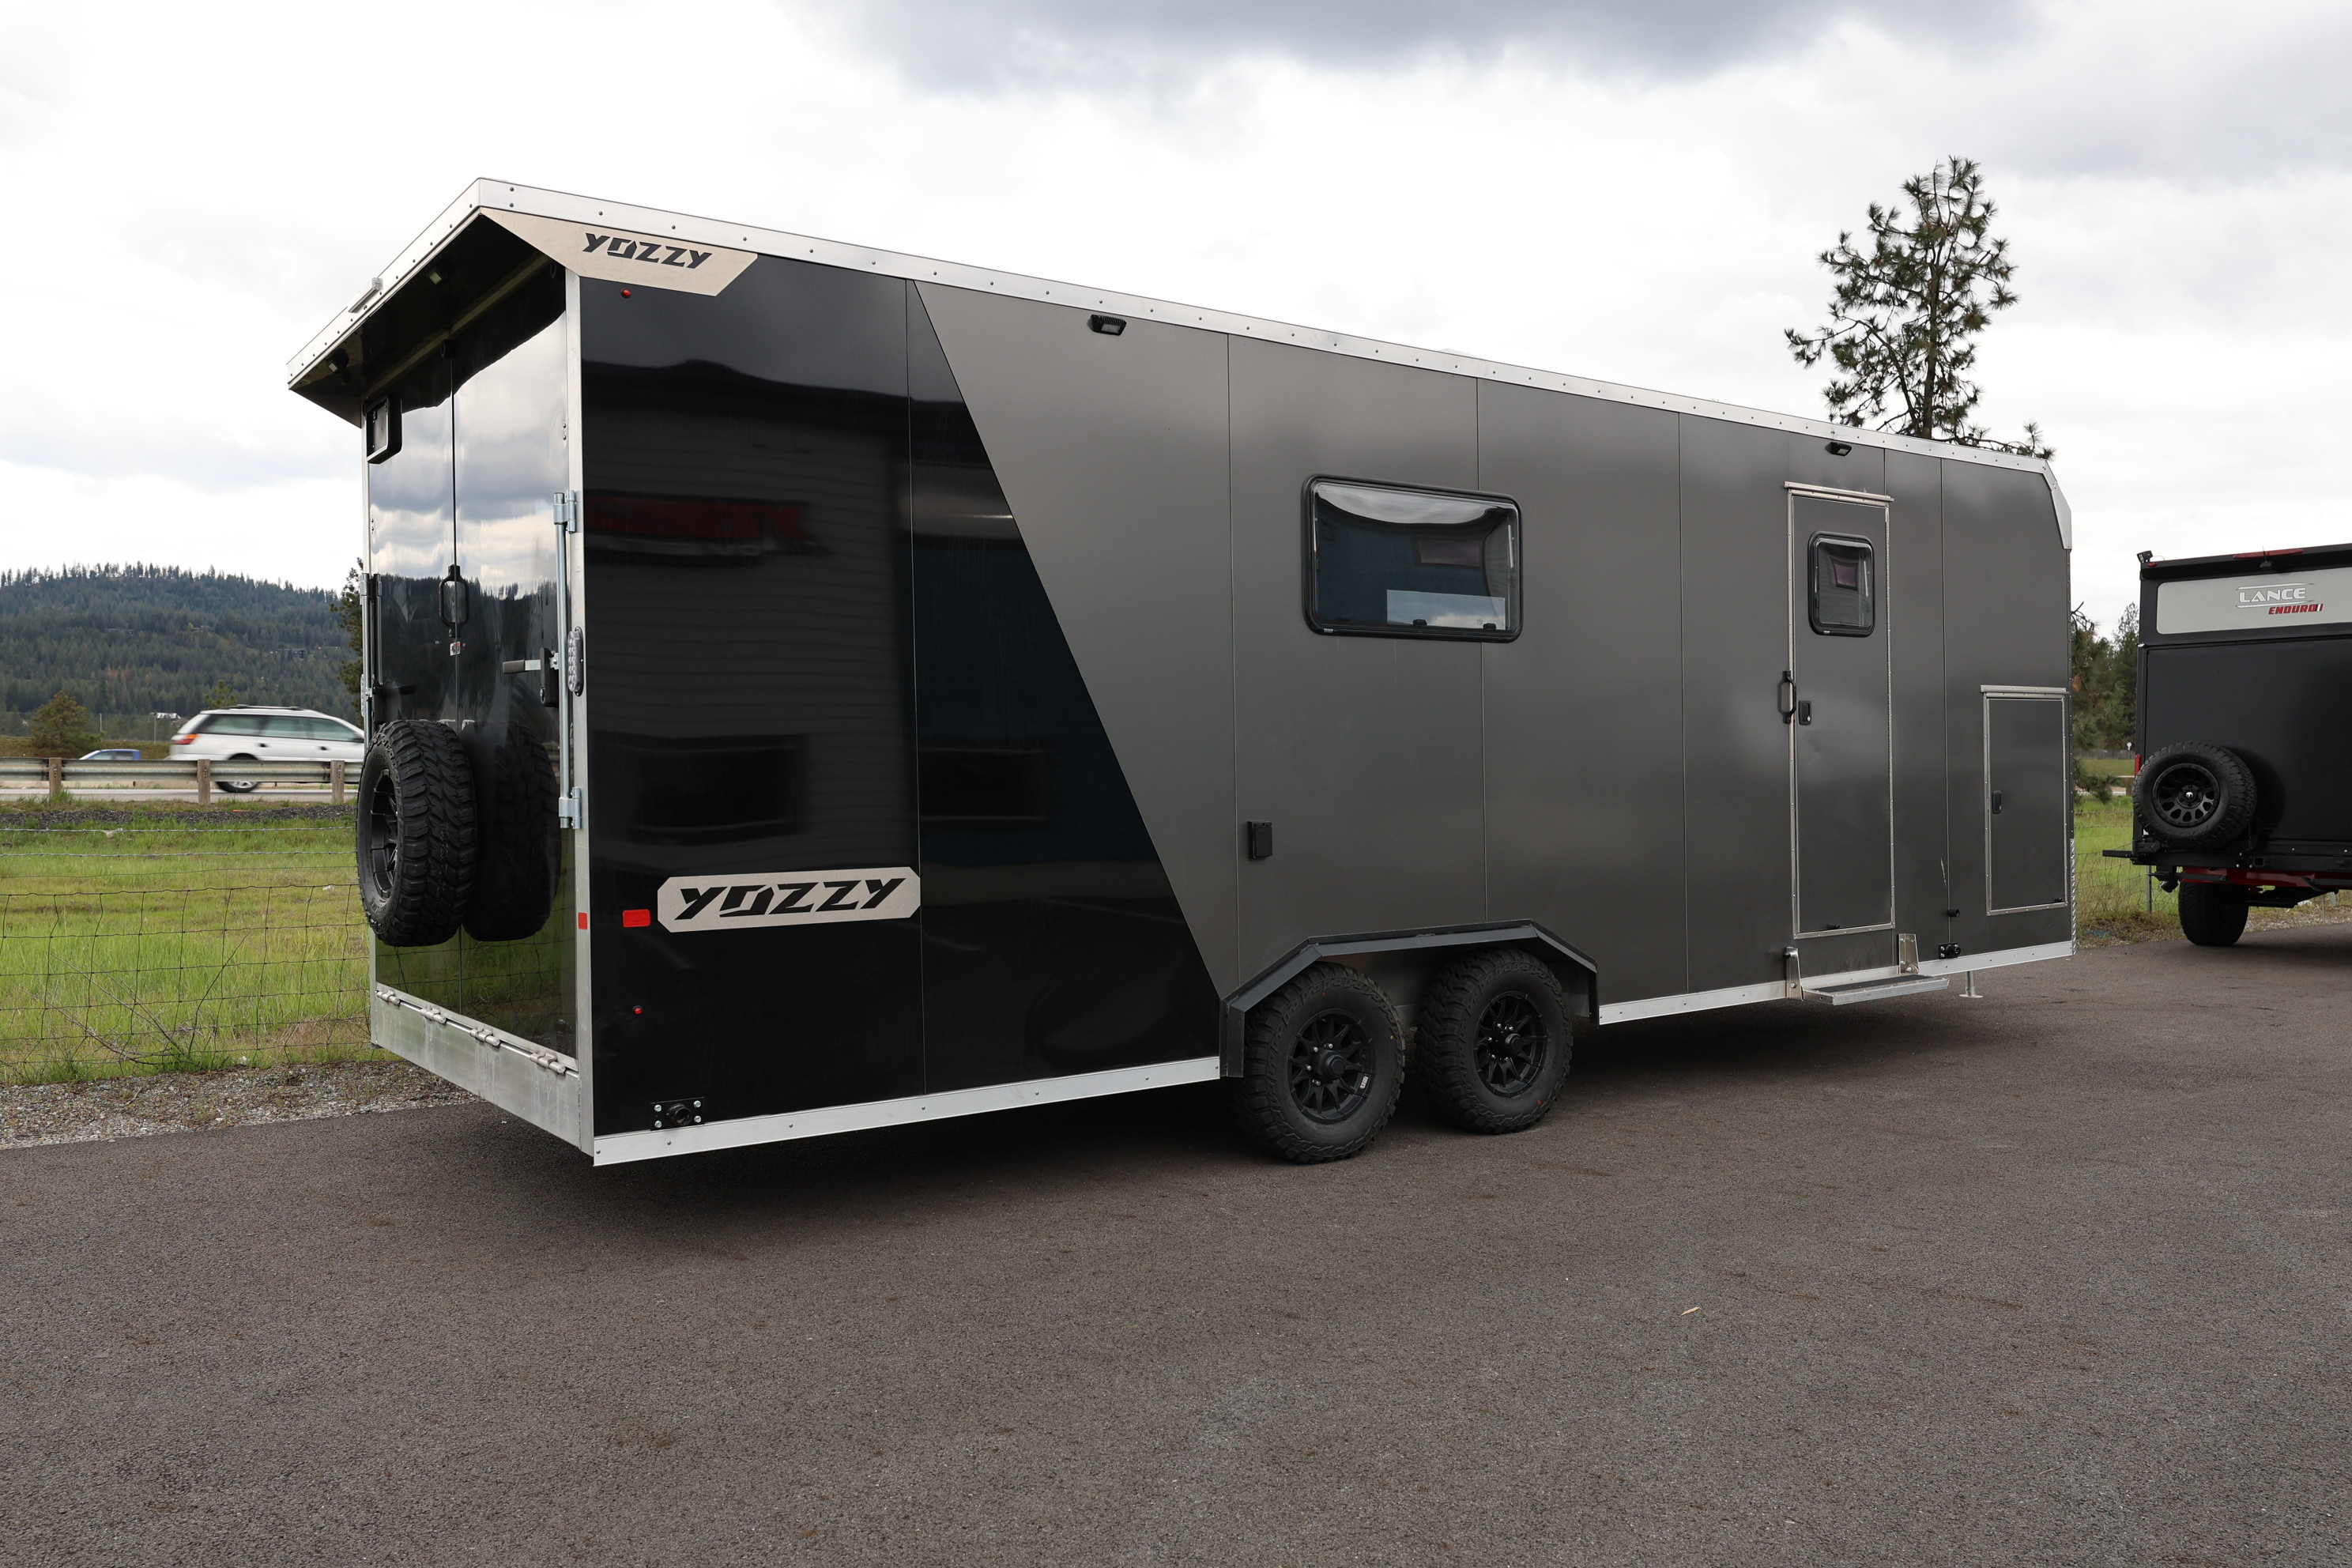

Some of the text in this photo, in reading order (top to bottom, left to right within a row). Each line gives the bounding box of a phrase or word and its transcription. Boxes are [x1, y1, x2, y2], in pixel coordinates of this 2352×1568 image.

[582, 232, 713, 270] YOZZY
[2239, 587, 2306, 603] LANCE
[2268, 604, 2318, 615] ENDURO
[674, 877, 907, 921] YOZZY
